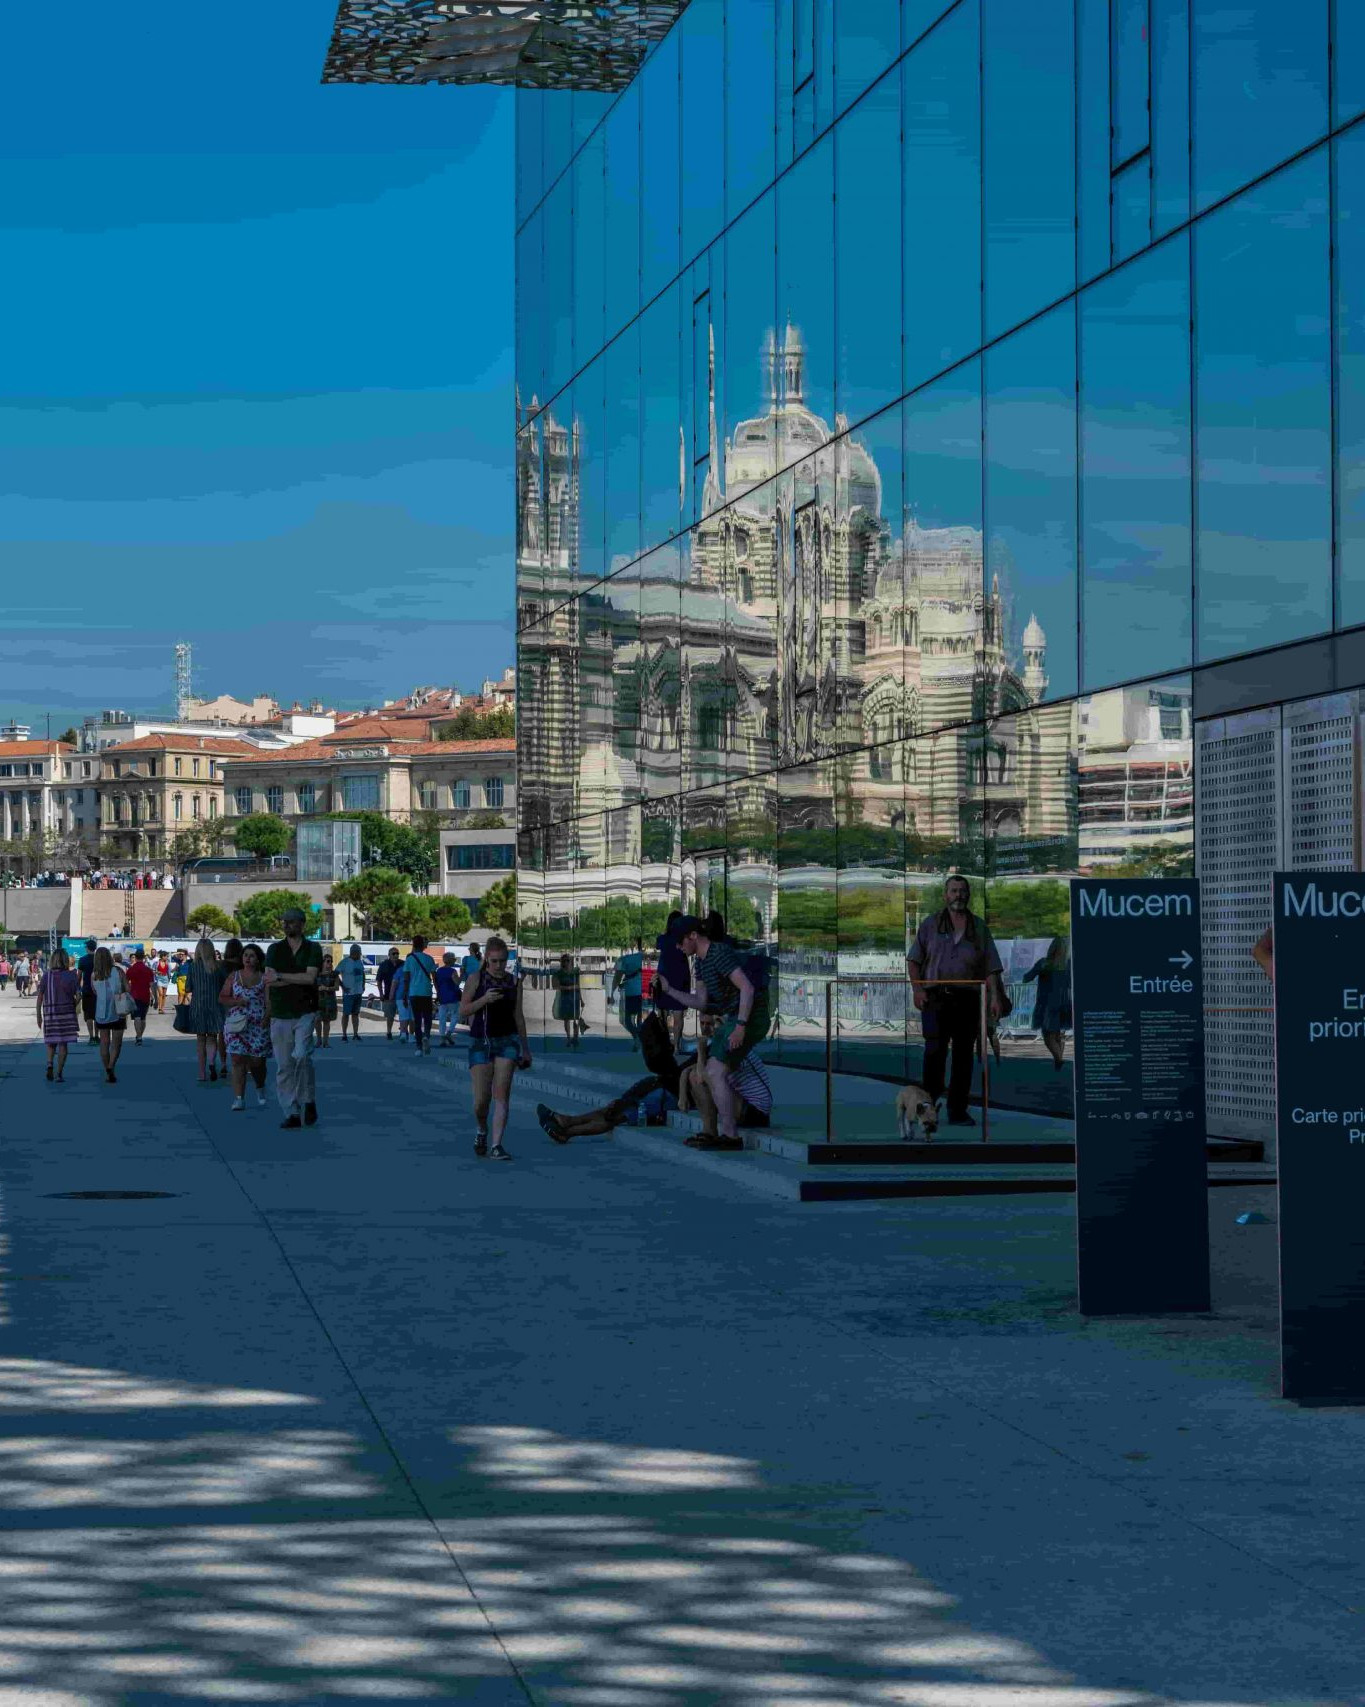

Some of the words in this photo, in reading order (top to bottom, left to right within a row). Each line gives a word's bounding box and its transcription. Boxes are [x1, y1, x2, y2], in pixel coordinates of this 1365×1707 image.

[1080, 888, 1192, 917] Mucem
[1284, 883, 1365, 917] Muc
[1129, 975, 1193, 993] Entrée
[1292, 1107, 1339, 1123] Carte
[1343, 1107, 1365, 1126] pri
